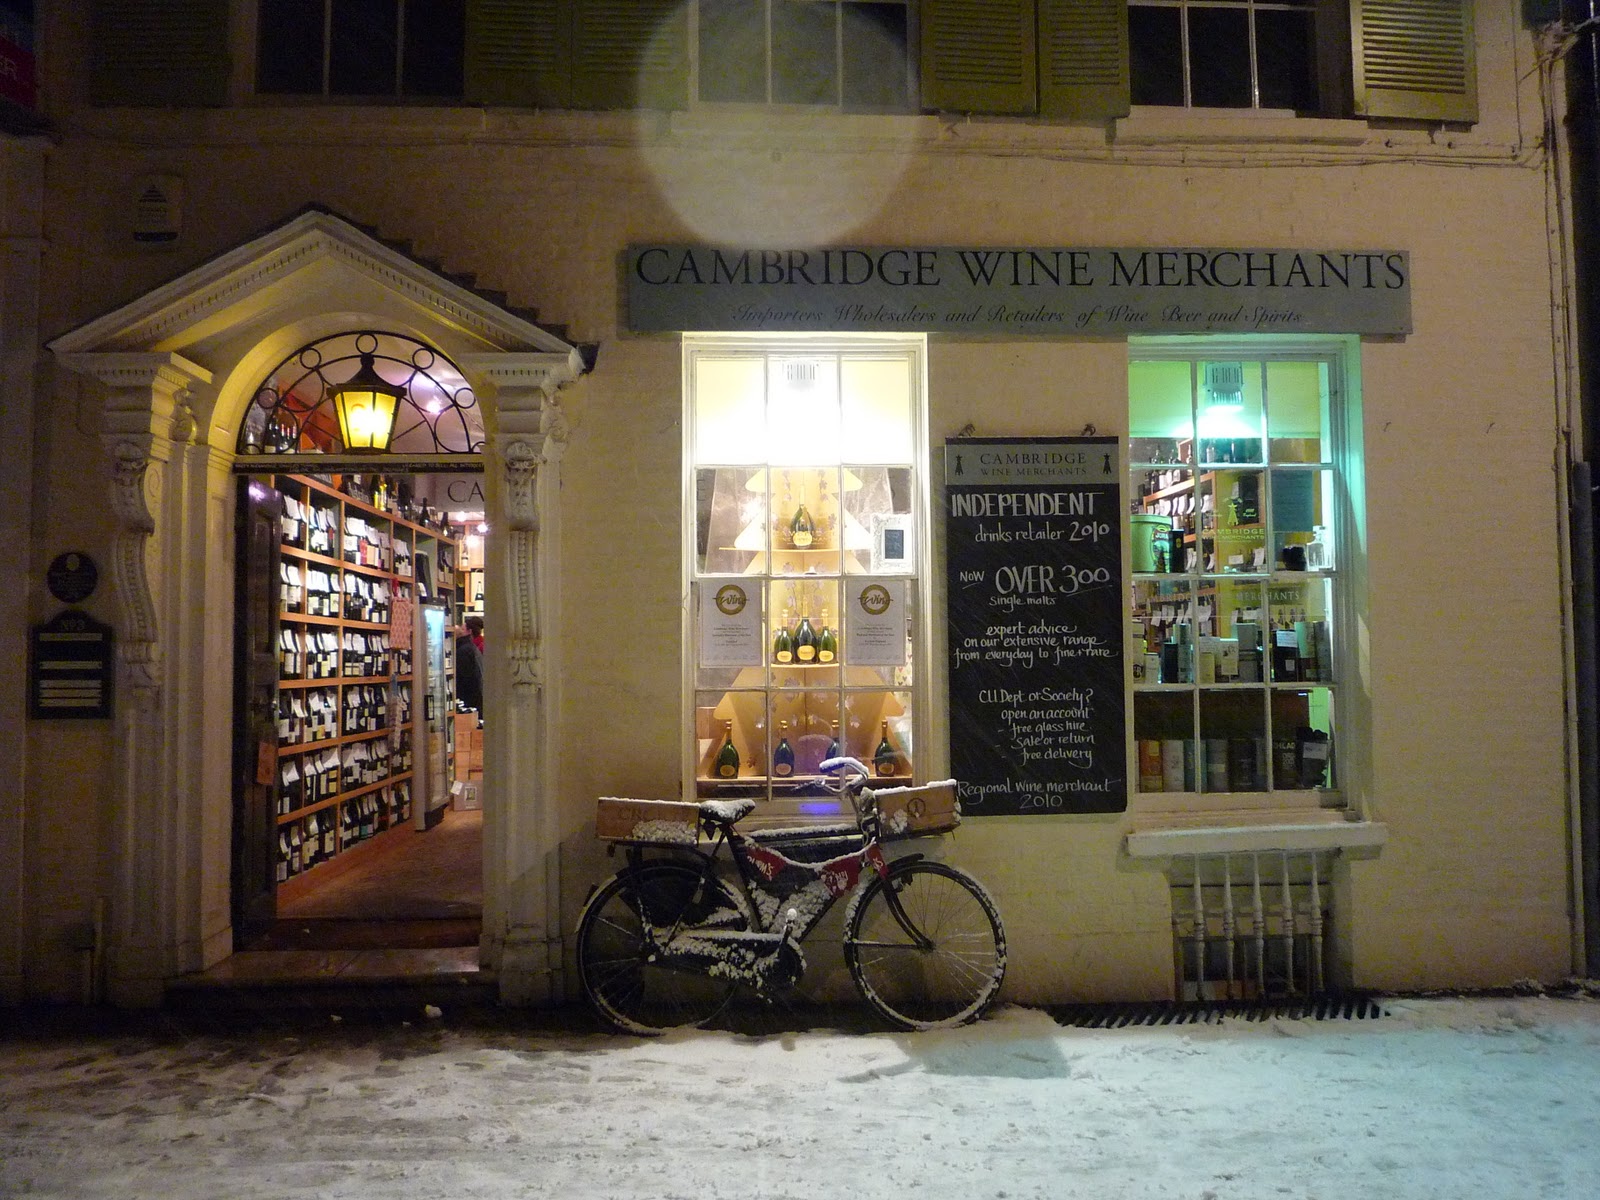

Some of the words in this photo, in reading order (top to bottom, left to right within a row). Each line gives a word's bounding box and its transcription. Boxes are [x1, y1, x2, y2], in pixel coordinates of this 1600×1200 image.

[635, 248, 941, 286] CAMBRIDGE
[955, 250, 1094, 287] WINE
[1108, 250, 1405, 290] MERCHANTS
[731, 304, 824, 328] Importers
[834, 304, 935, 323] Wholesalers
[945, 305, 977, 322] and
[986, 304, 1064, 324] Retailers
[1077, 304, 1102, 328] of
[1105, 304, 1149, 323] Wine
[1162, 305, 1201, 323] Beer
[1207, 304, 1248, 323] and
[1244, 304, 1301, 328] Spirits
[979, 452, 1087, 465] CAMBRIDGE
[1016, 468, 1087, 476] MERCHANTS
[951, 492, 1104, 517] INDEPENDENT
[975, 522, 1012, 542] drinks
[1016, 521, 1064, 540] retailer
[1069, 521, 1110, 542] 2010
[995, 565, 1057, 595] OVER
[1059, 564, 1110, 594] 300
[989, 594, 1026, 613] single
[1026, 594, 1057, 606] malts
[986, 621, 1026, 641] expert
[1028, 619, 1077, 634] advice
[964, 637, 978, 648] on
[981, 636, 998, 648] our
[1003, 635, 1059, 648] extensive
[1063, 635, 1107, 651] range
[954, 648, 980, 669] from
[985, 649, 1034, 669] everyday
[1039, 647, 1049, 659] to
[1000, 689, 1025, 707] Dept
[1028, 691, 1041, 702] or
[1001, 709, 1027, 725] open
[1029, 709, 1044, 719] an
[1047, 707, 1092, 719] account
[1011, 722, 1033, 741] free
[1035, 722, 1064, 739] glass
[1066, 720, 1086, 731] hire
[1043, 737, 1053, 745] or
[1058, 733, 1095, 744] return
[1022, 749, 1042, 766] free
[1044, 748, 1093, 770] delivery
[957, 778, 1013, 806] Regional
[1046, 779, 1121, 793] merchant
[1020, 794, 1063, 809] 2010
